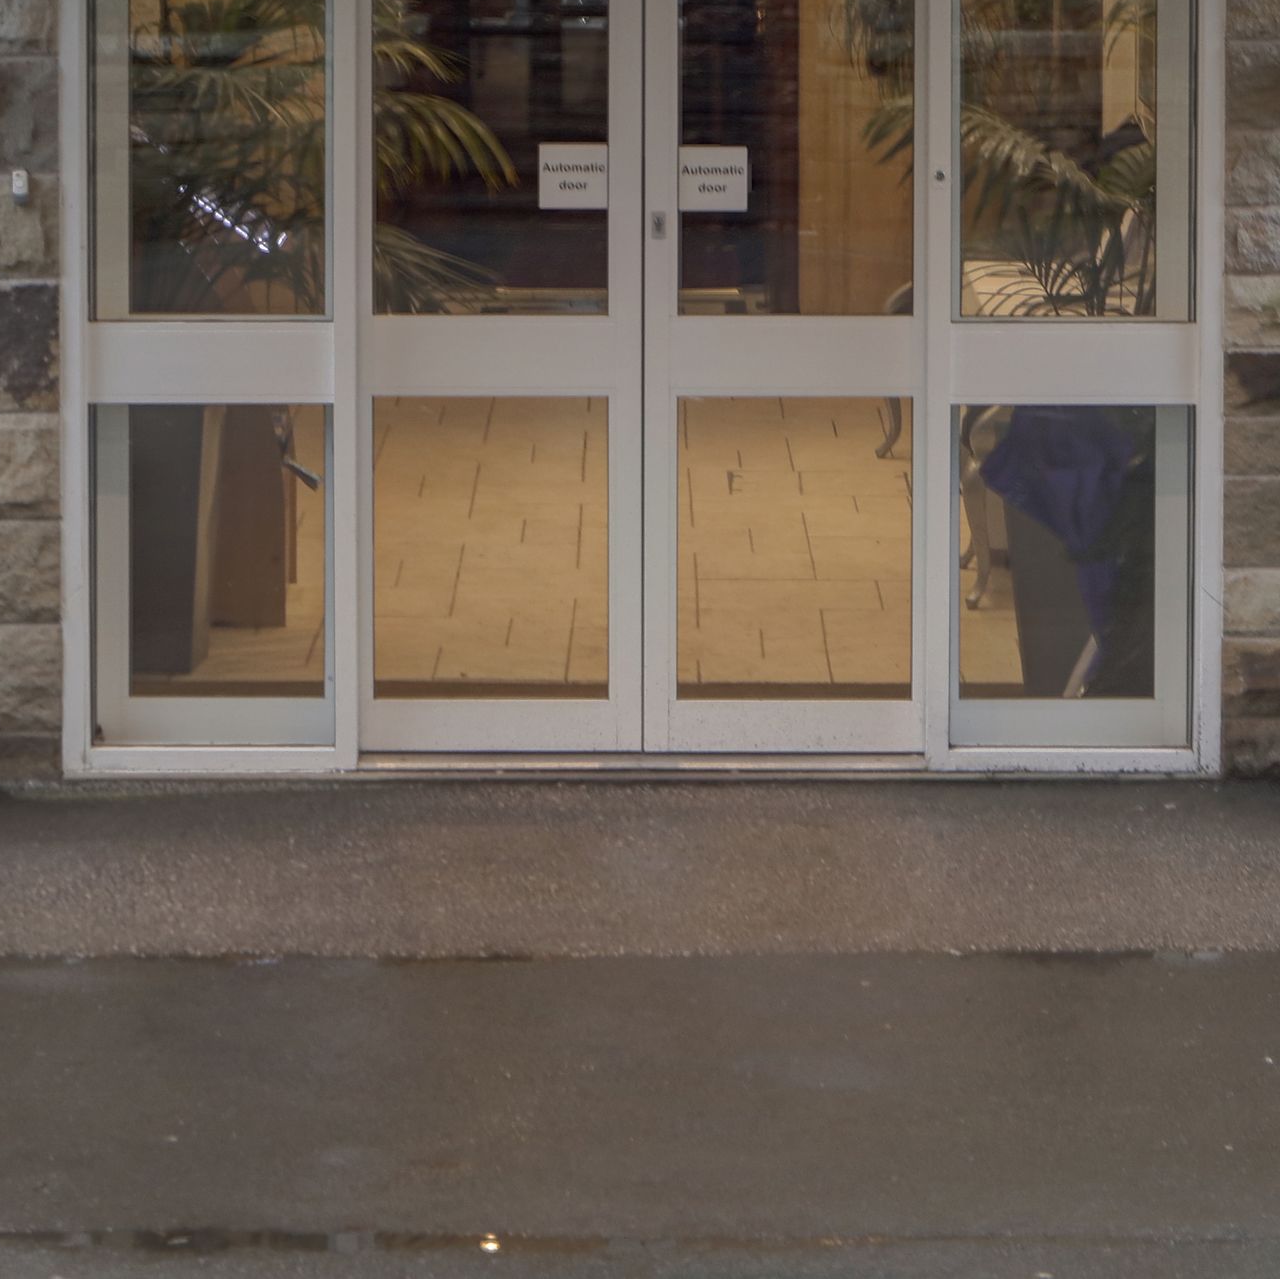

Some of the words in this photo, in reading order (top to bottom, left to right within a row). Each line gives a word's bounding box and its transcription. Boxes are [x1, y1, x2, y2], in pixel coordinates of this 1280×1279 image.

[543, 162, 605, 173] Automatic
[682, 165, 744, 175] Automatic
[559, 180, 587, 191] door
[698, 183, 727, 193] door
